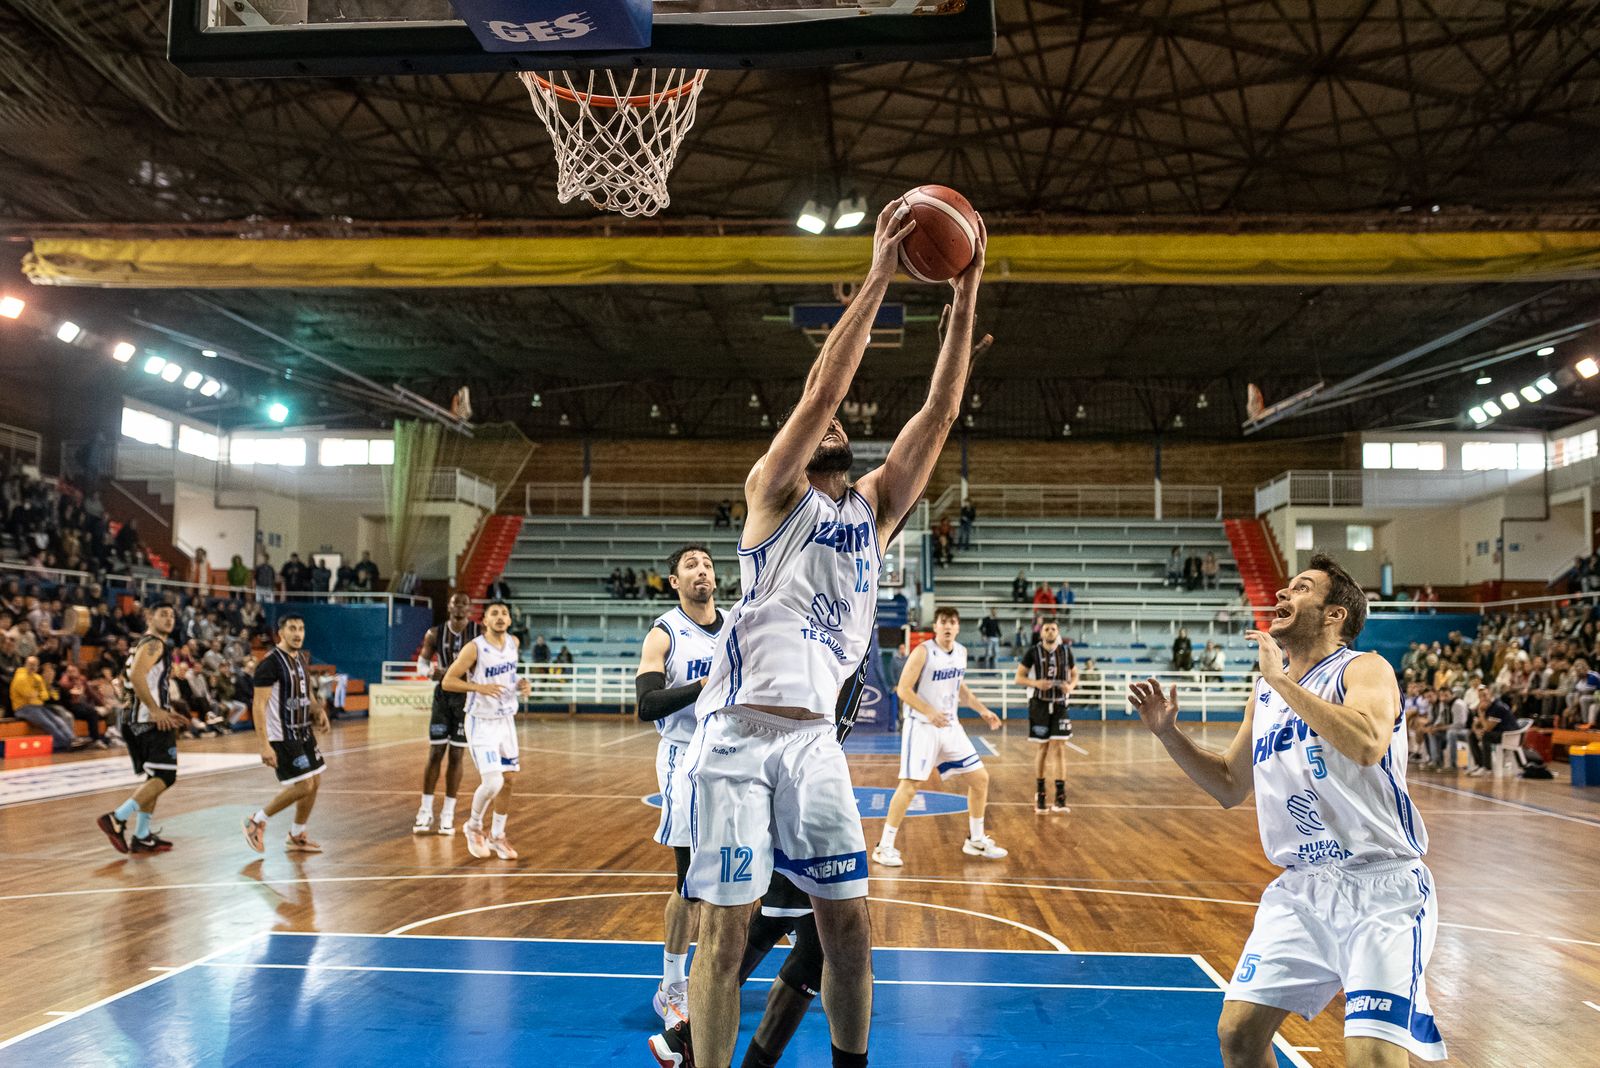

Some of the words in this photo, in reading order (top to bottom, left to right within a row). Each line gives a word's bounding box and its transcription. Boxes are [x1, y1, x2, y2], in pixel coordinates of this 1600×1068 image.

[485, 12, 594, 42] GES
[801, 628, 818, 640] TE
[1306, 745, 1328, 779] 5
[720, 846, 753, 883] 12
[1237, 954, 1262, 983] 5
